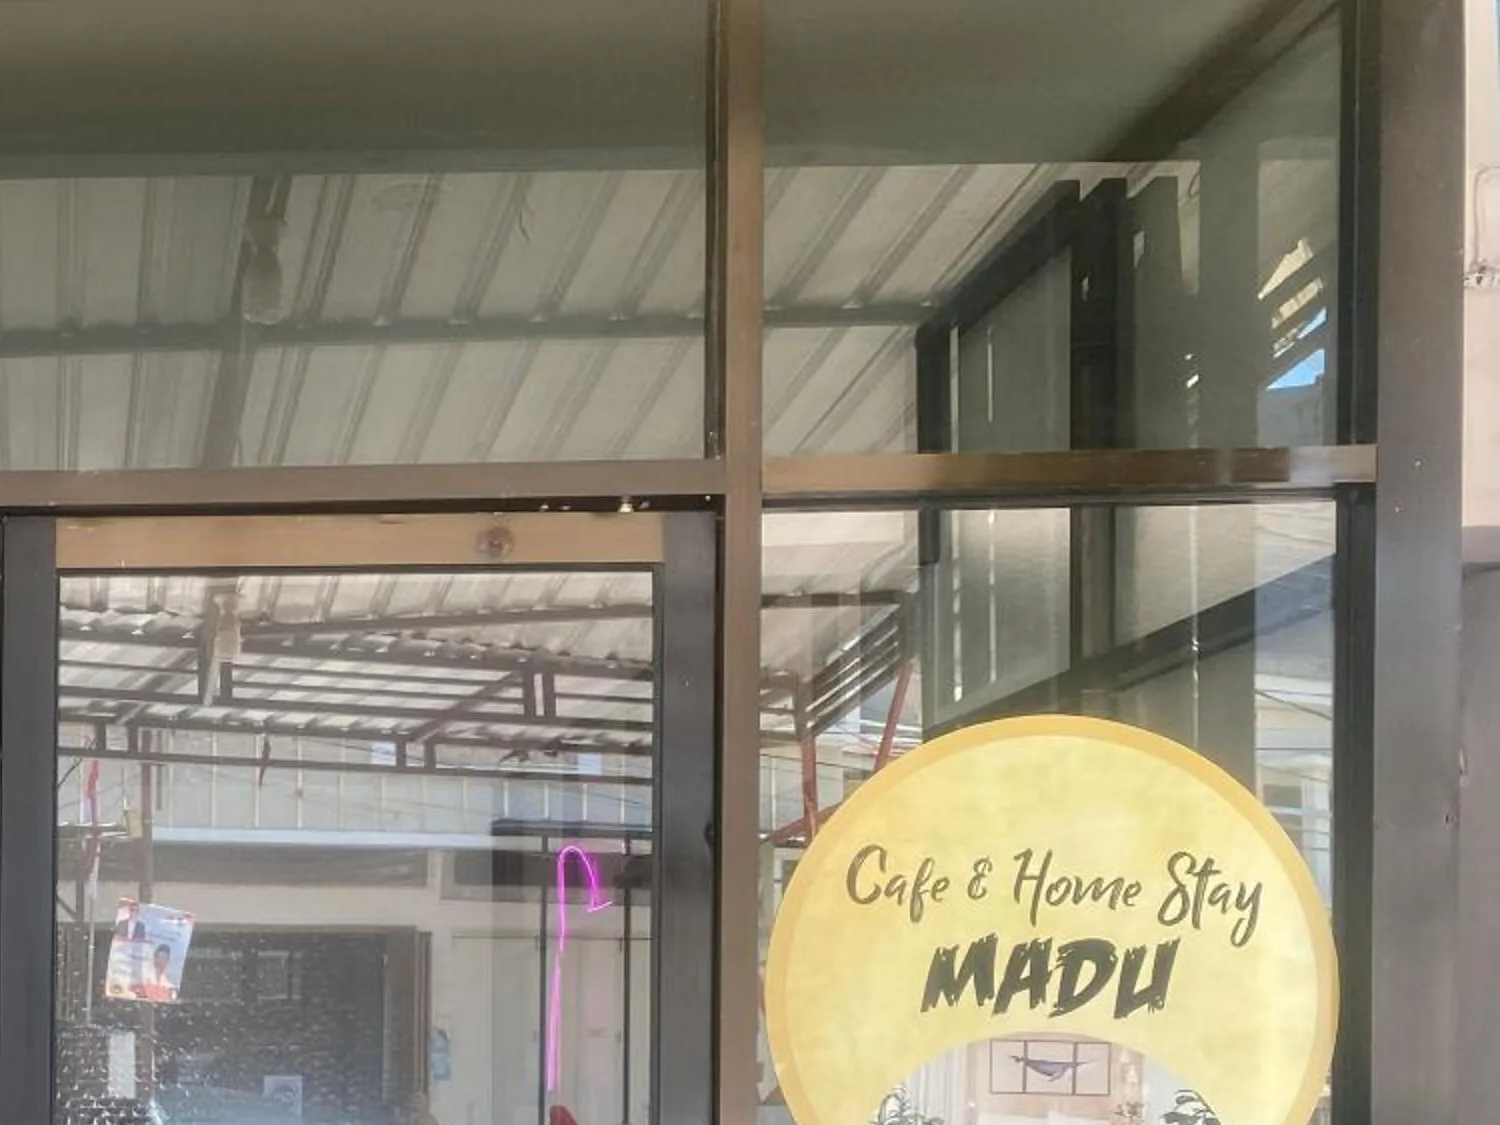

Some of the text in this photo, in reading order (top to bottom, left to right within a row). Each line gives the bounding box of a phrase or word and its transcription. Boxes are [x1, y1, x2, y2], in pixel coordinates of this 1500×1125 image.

[845, 844, 1263, 947] Cafe & Home Stay
[920, 932, 1182, 1021] MADU
